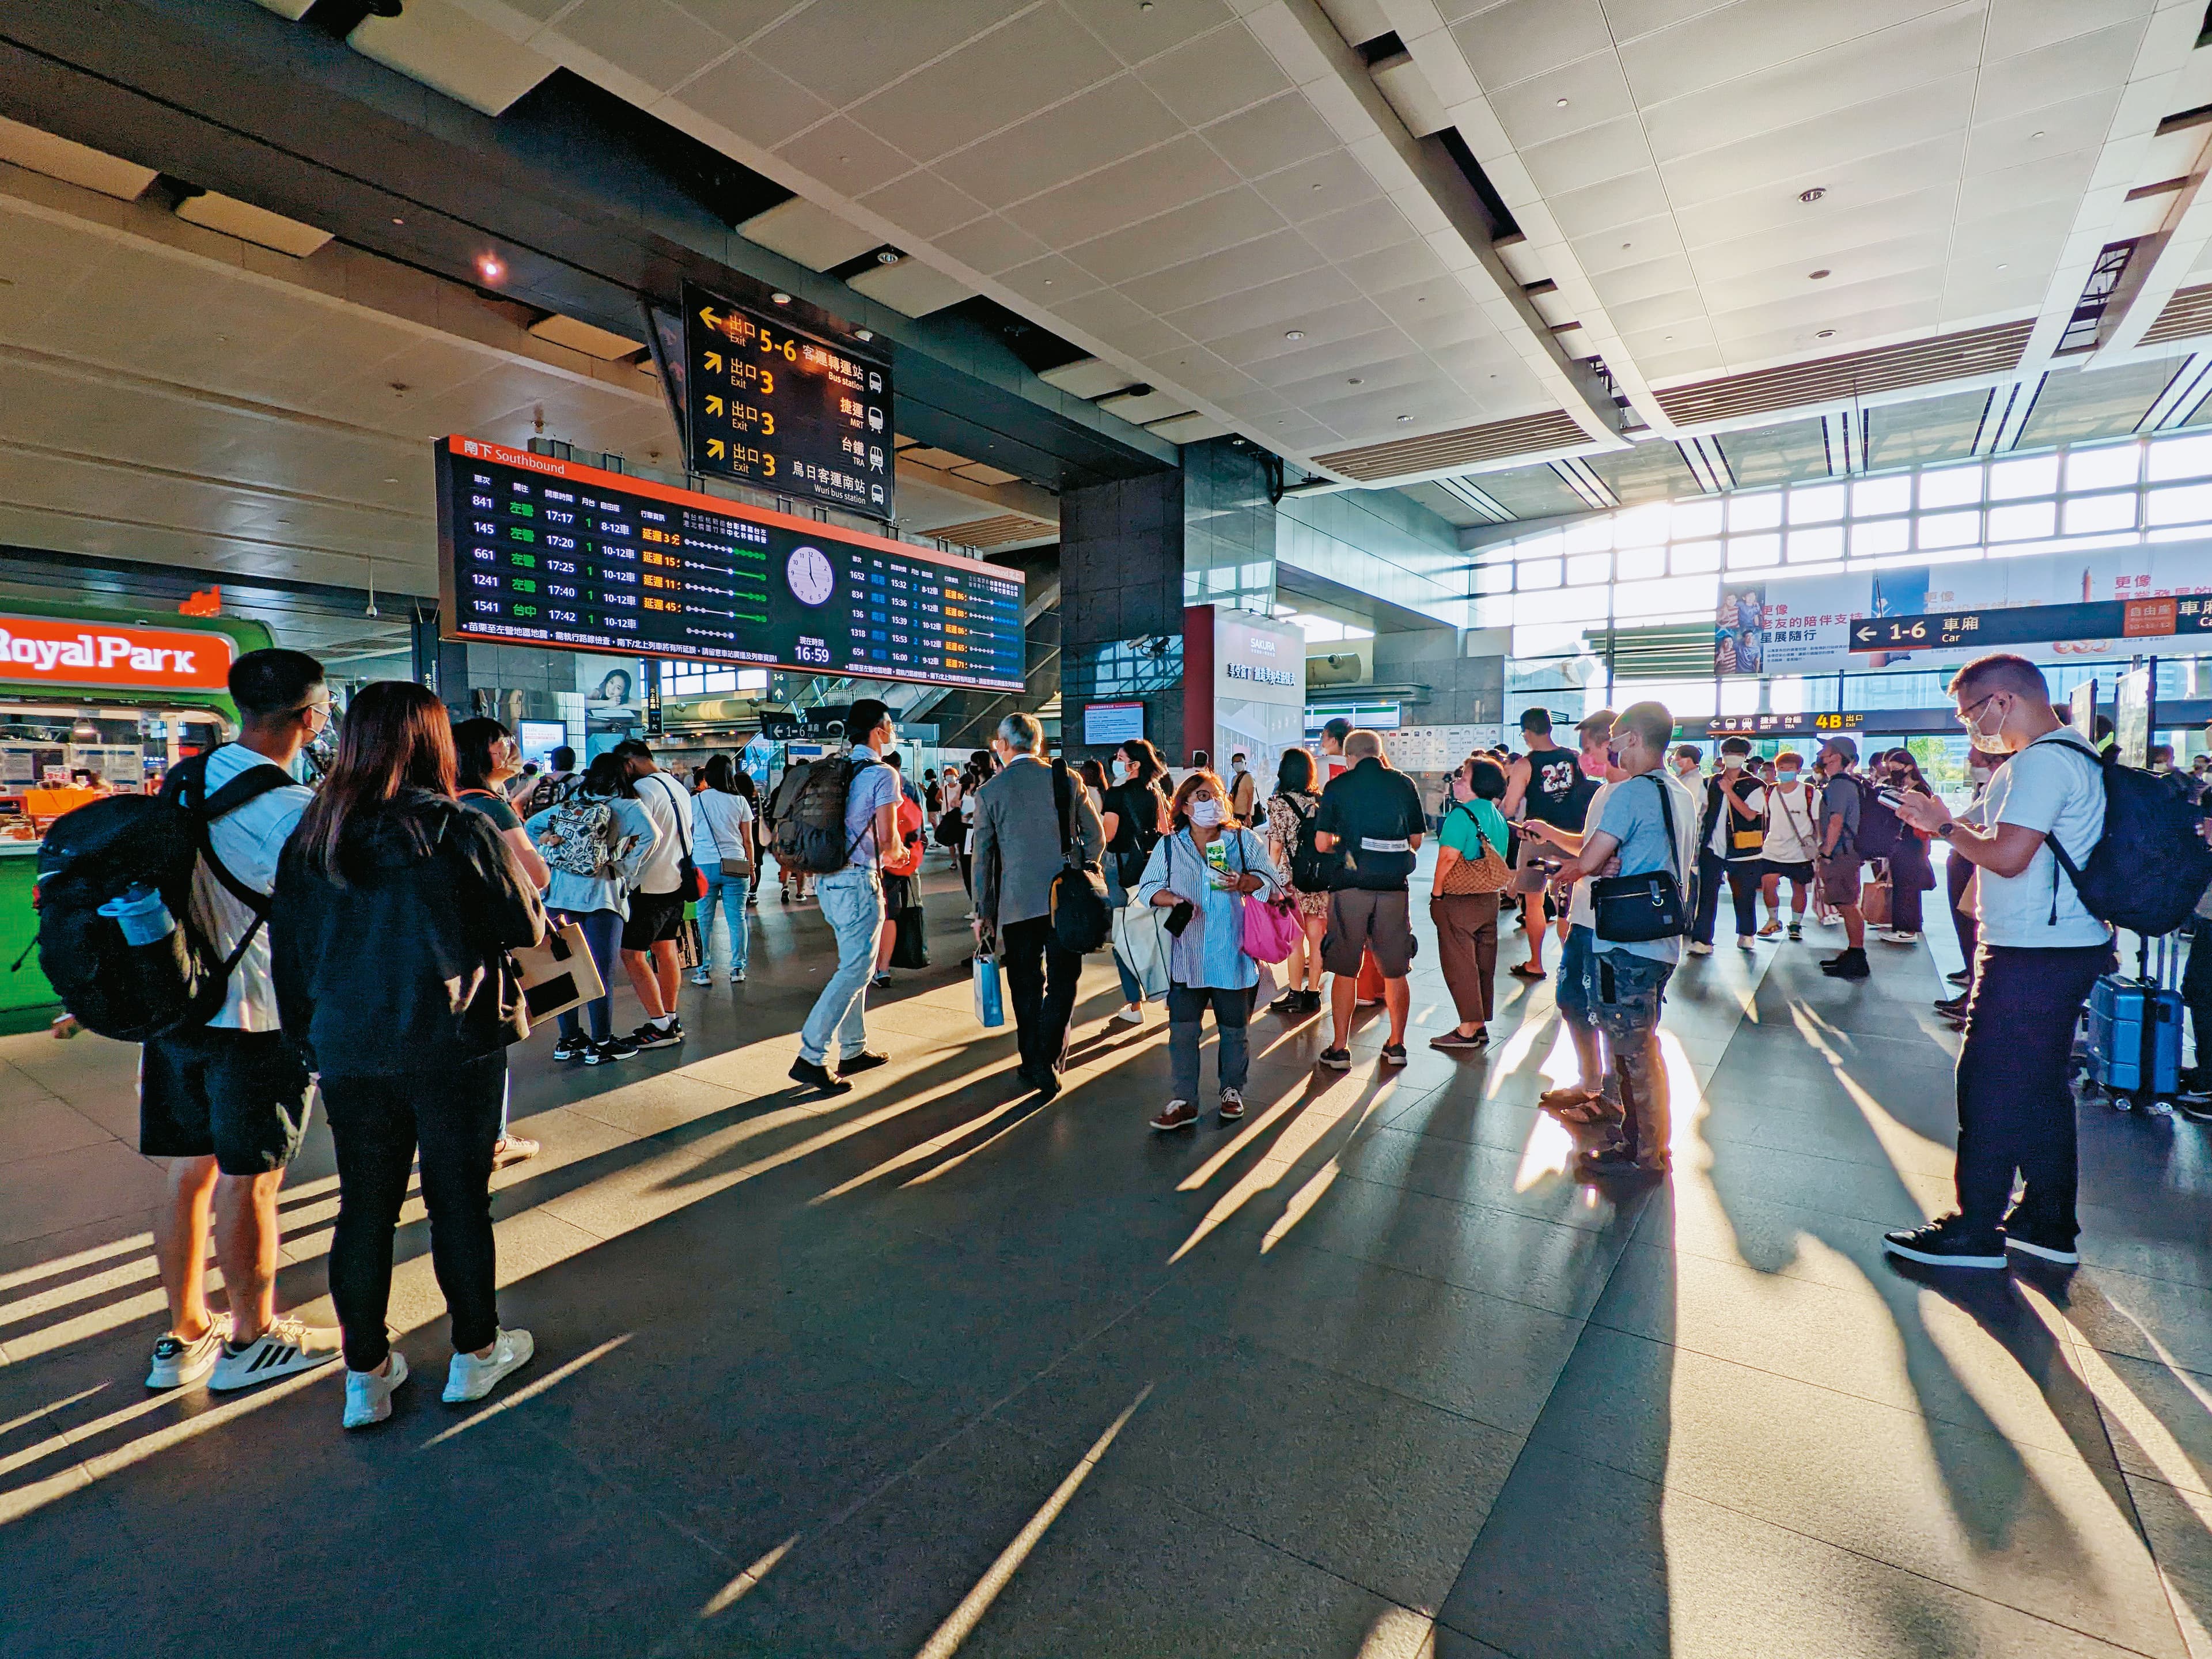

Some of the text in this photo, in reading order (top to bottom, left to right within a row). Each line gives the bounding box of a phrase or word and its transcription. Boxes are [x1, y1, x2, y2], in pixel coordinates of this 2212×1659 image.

[730, 315, 796, 361] 出口 5-6
[730, 332, 747, 347] Exit
[803, 345, 863, 381] 客運轉運站
[731, 358, 774, 394] 出口 3
[731, 376, 747, 389] Exit
[828, 372, 863, 392] Bus station
[840, 397, 863, 419] 捷運
[732, 400, 775, 435] 出口 3
[732, 418, 748, 431] Exit
[850, 418, 864, 429] MRT
[842, 437, 864, 456] 台鐵
[464, 440, 565, 475] 南下 Southbound
[733, 443, 775, 476] 出口 3
[853, 456, 865, 467] TRA
[734, 461, 749, 474] Exit
[474, 474, 491, 484] 車次
[582, 497, 595, 507] 月台
[814, 484, 866, 505] Wuri bus station
[600, 502, 620, 512] 自由座
[473, 495, 492, 508] 841
[546, 510, 573, 524] 17:17
[586, 518, 591, 528] 1
[601, 522, 630, 535] 8-12車
[642, 528, 662, 543] 延遲
[664, 534, 669, 543] 3
[641, 510, 665, 522] 行車資訊
[474, 522, 494, 534] 145
[547, 535, 574, 548] 17:20
[586, 543, 592, 552] 1
[602, 546, 635, 559] 10-12車
[643, 551, 662, 565] 延遲
[665, 556, 675, 566] 15
[474, 548, 494, 560] 661
[547, 560, 574, 573] 17:25
[587, 566, 592, 576] 1
[603, 570, 636, 582] 10-12車
[643, 574, 663, 588] 延遲
[665, 579, 675, 589] 11
[978, 565, 1008, 577] Northbound
[850, 570, 865, 581] 1652
[891, 579, 907, 589] 15:32
[2115, 574, 2152, 589] 更像
[472, 574, 498, 586] 1241
[548, 585, 575, 597] 17:40
[588, 590, 593, 600] 1
[604, 593, 637, 606] 10-12車
[643, 597, 664, 611] 延遲
[665, 602, 676, 612] 45
[851, 590, 863, 600] 834
[891, 598, 907, 607] 15:36
[473, 600, 637, 630] 1541 台中 17:42 1 10-12車
[852, 609, 864, 618] 136
[892, 616, 907, 626] 15:39
[1762, 604, 1788, 616] 更像
[850, 628, 866, 638] 1318
[892, 634, 908, 643] 15:53
[1890, 616, 1979, 639] 1-6 車廂
[800, 636, 824, 647] 現在時刻
[1760, 630, 1817, 643] 星展隨行
[1942, 634, 1960, 642] Car
[0, 628, 196, 673] Royal Park
[1251, 638, 1276, 652] SAKURA
[795, 646, 829, 662] 16:59
[853, 647, 864, 656] 654
[892, 653, 908, 661] 16:00
[1816, 714, 1842, 729] 4B
[786, 725, 805, 737] 1-6
[1541, 761, 1572, 793] 23
